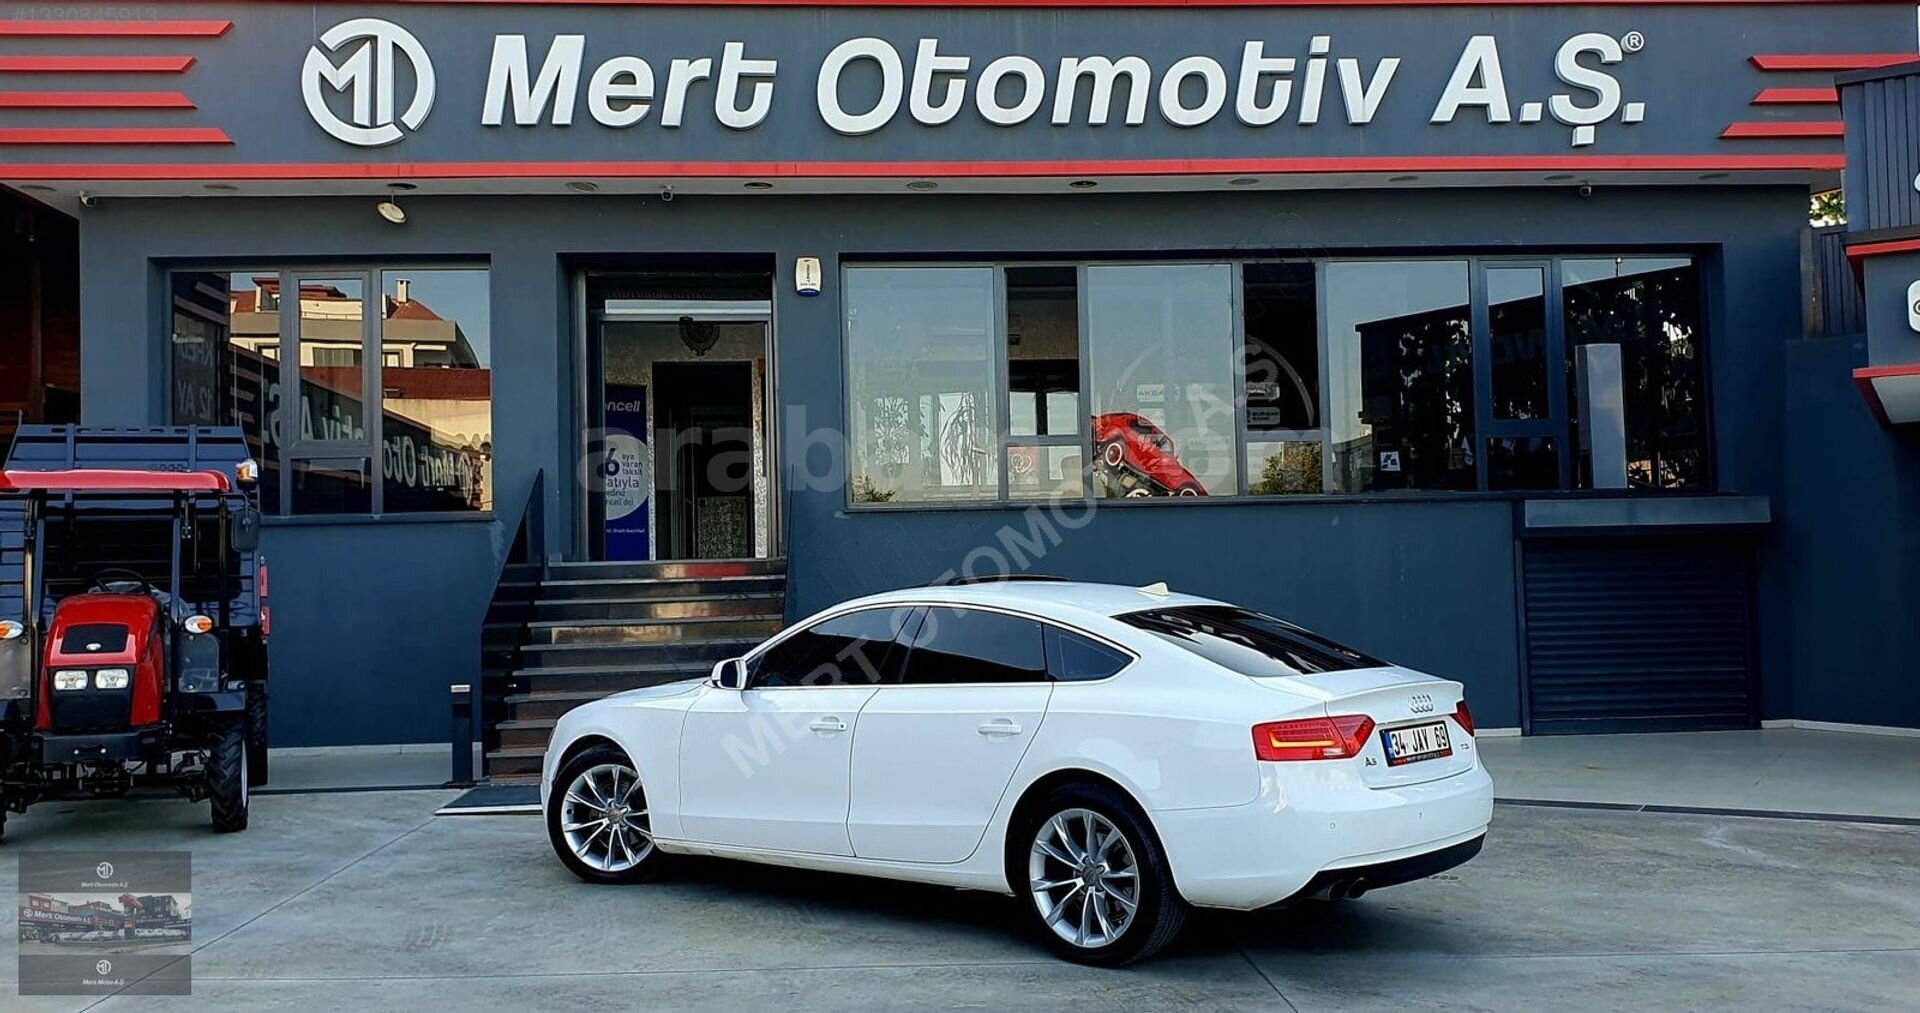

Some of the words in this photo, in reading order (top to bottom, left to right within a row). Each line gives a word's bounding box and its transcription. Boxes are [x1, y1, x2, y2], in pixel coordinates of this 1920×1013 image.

[481, 34, 777, 129] Mert
[816, 35, 1400, 137] Otomotiv
[604, 400, 641, 412] ncell
[1391, 732, 1407, 756] 34
[1434, 726, 1448, 748] 69
